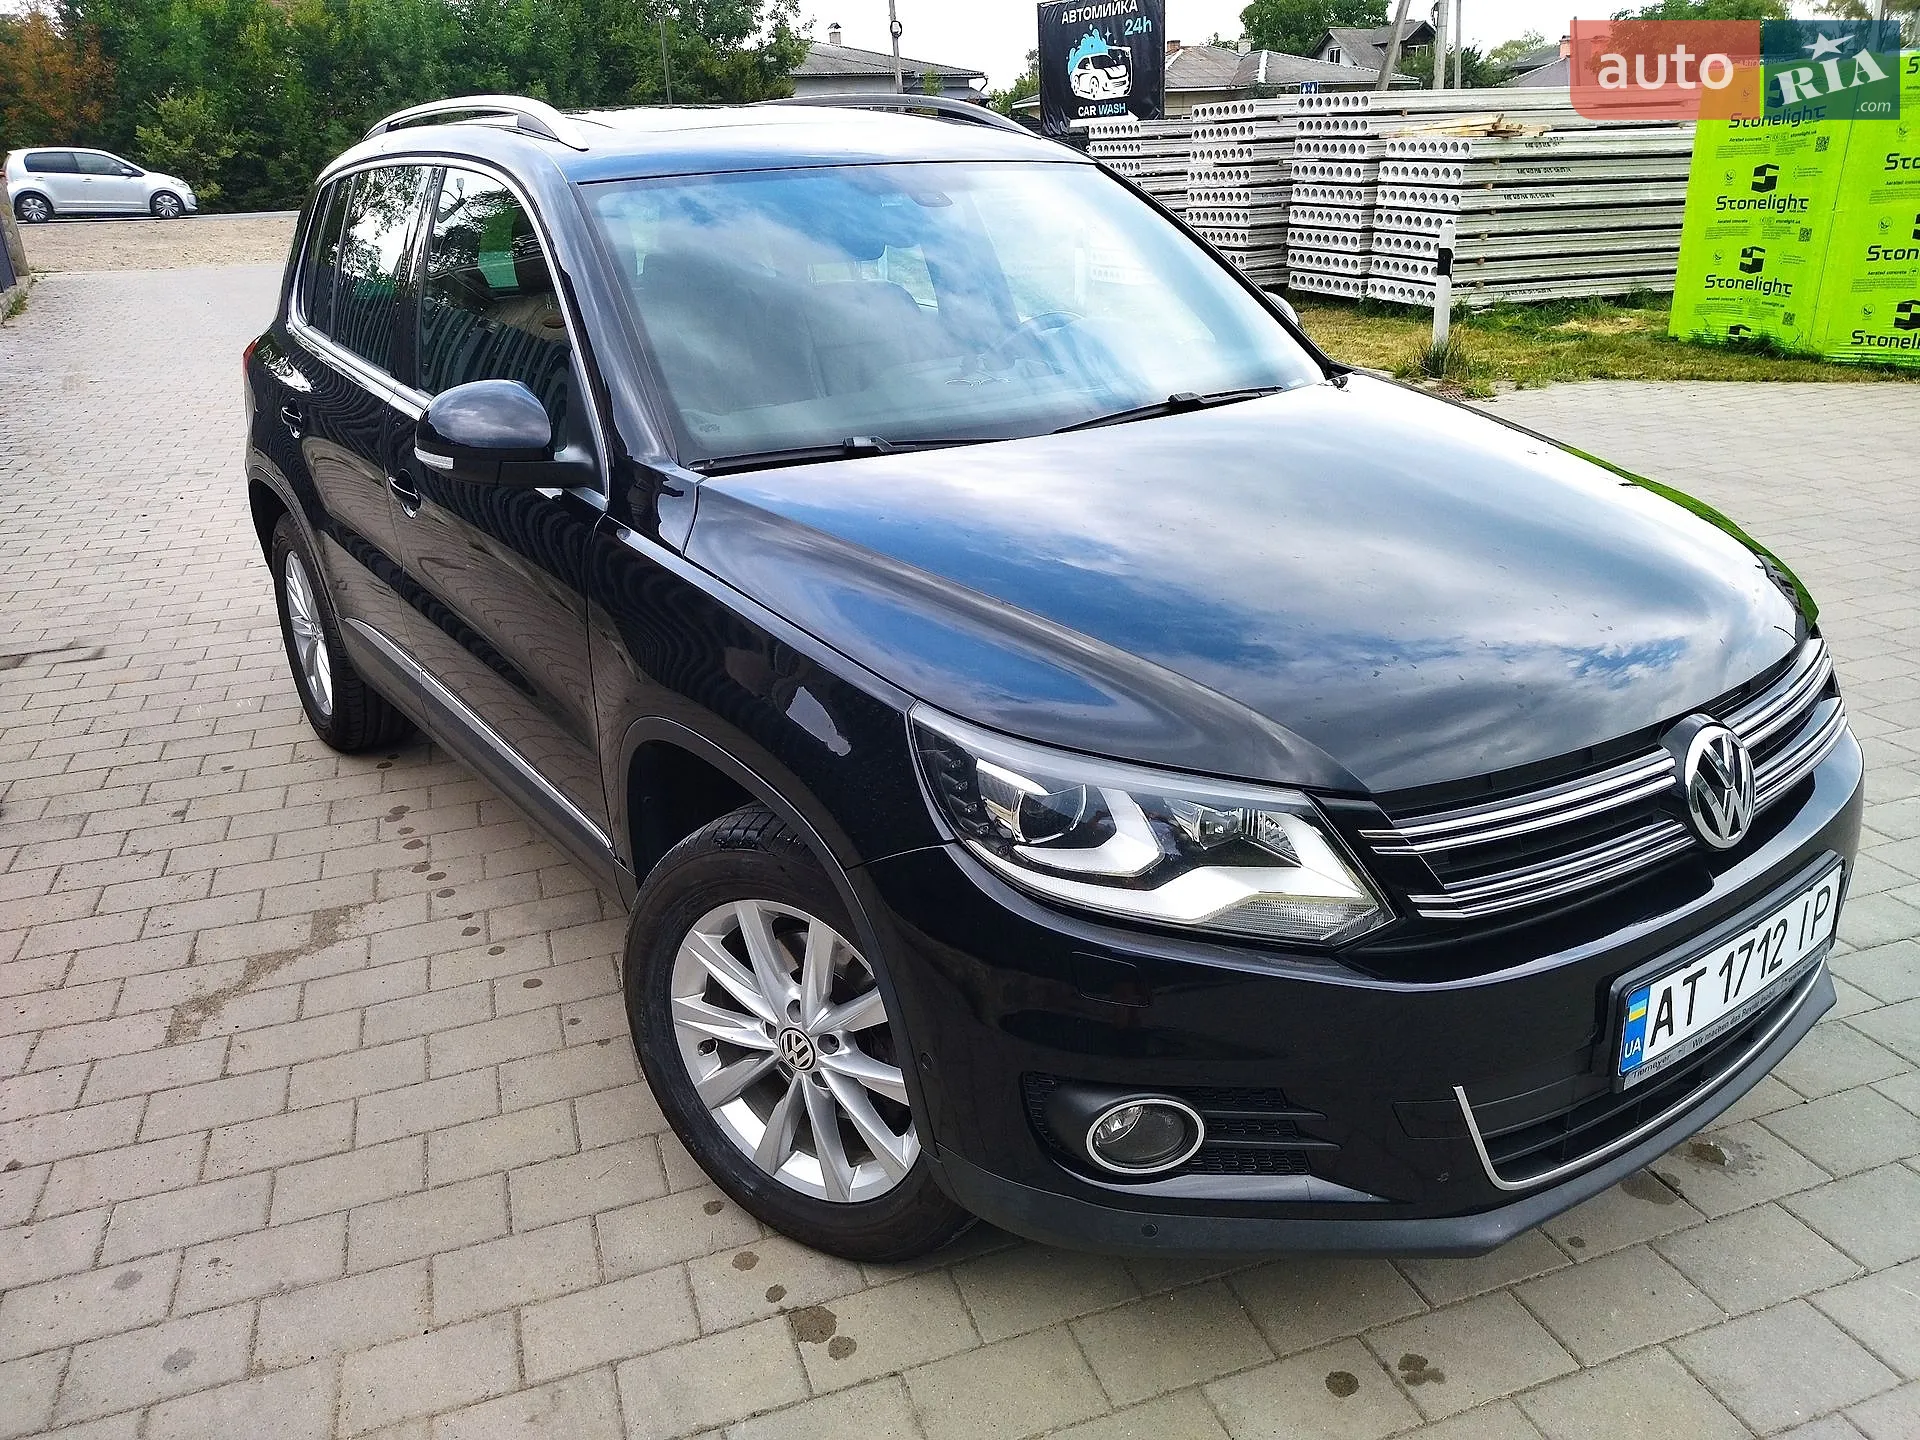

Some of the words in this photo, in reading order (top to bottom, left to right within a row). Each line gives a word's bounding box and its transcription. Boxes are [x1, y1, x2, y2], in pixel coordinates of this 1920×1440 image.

[1062, 0, 1138, 24] АВТОМИЙКА
[1125, 16, 1152, 35] 24h
[1078, 106, 1096, 116] CAR
[1098, 103, 1126, 115] WASH
[1728, 105, 1827, 128] Stonelight
[1716, 193, 1809, 213] Stonelight
[1704, 274, 1793, 295] Stonelight
[1648, 966, 1708, 1048] AT
[1718, 918, 1788, 1005] 1712
[1799, 885, 1831, 951] IP
[1624, 1036, 1642, 1059] UA
